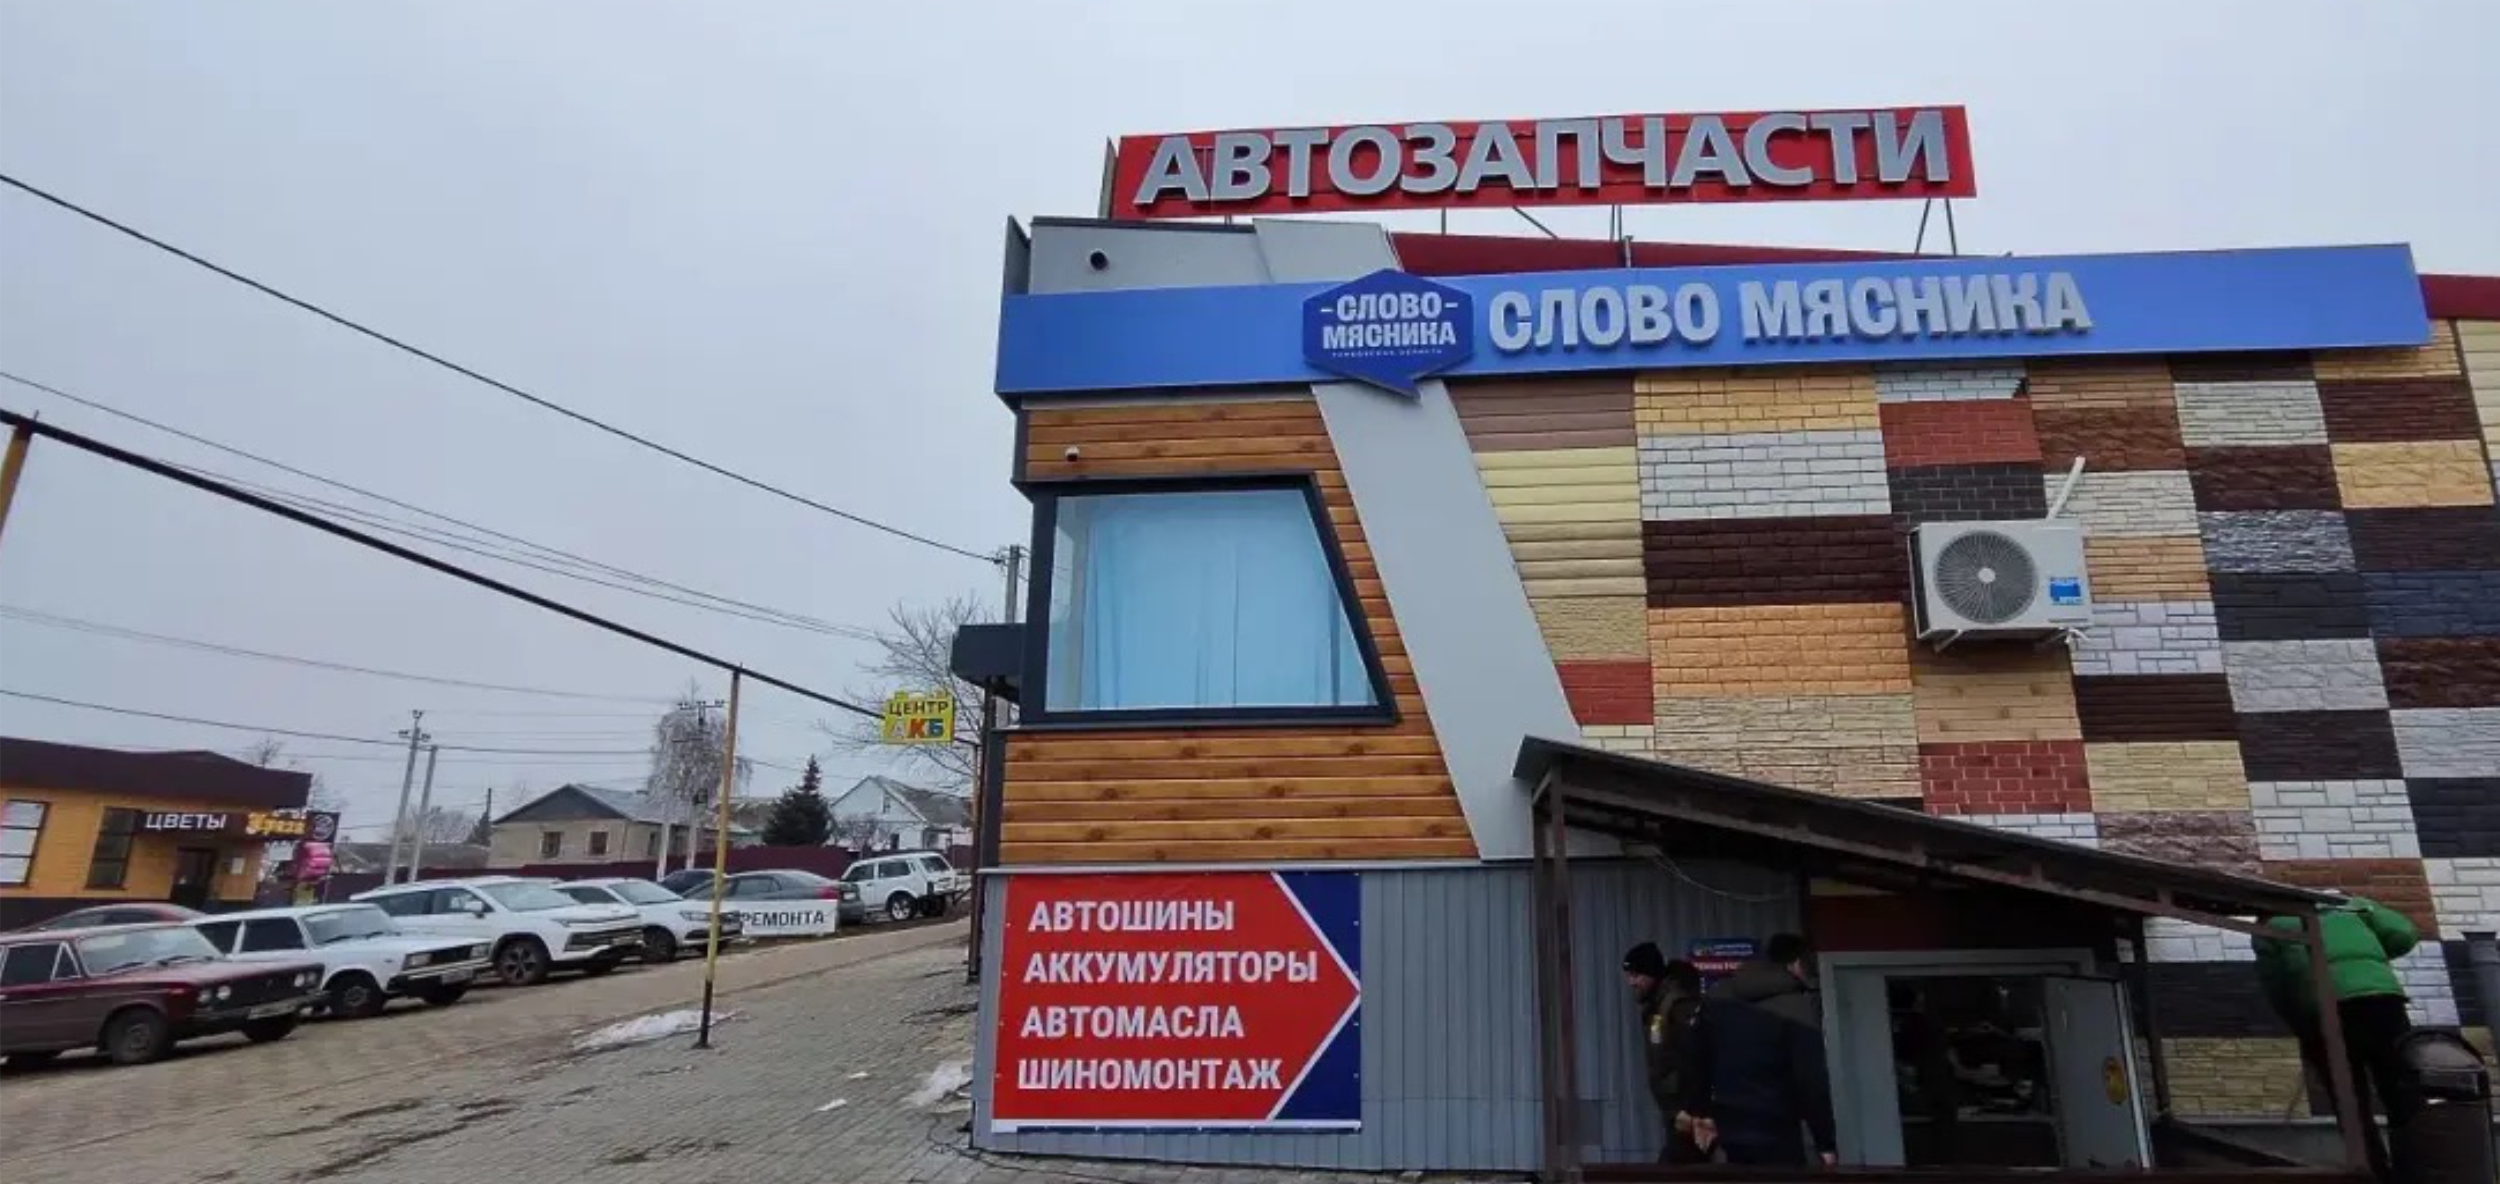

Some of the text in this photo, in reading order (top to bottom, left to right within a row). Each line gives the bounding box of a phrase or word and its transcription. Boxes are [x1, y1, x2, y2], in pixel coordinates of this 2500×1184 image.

[1134, 109, 1952, 205] АВТОЗАПЧАСТИ
[1489, 271, 2093, 352] СЛОВО МЯСНИКА
[1323, 321, 1456, 349] МЯСНИКА
[889, 701, 949, 716] ЦЕНТР
[892, 718, 944, 739] АКБ
[145, 813, 227, 831] ЦВЕТЫ
[1028, 900, 1235, 932] АВТОШИНЫ
[1023, 951, 1319, 984] АККУМУЛЯТОРЫ
[1020, 1005, 1246, 1039] АВТОМАСЛА
[1017, 1058, 1284, 1090] ШИНОМОНТАЖ
